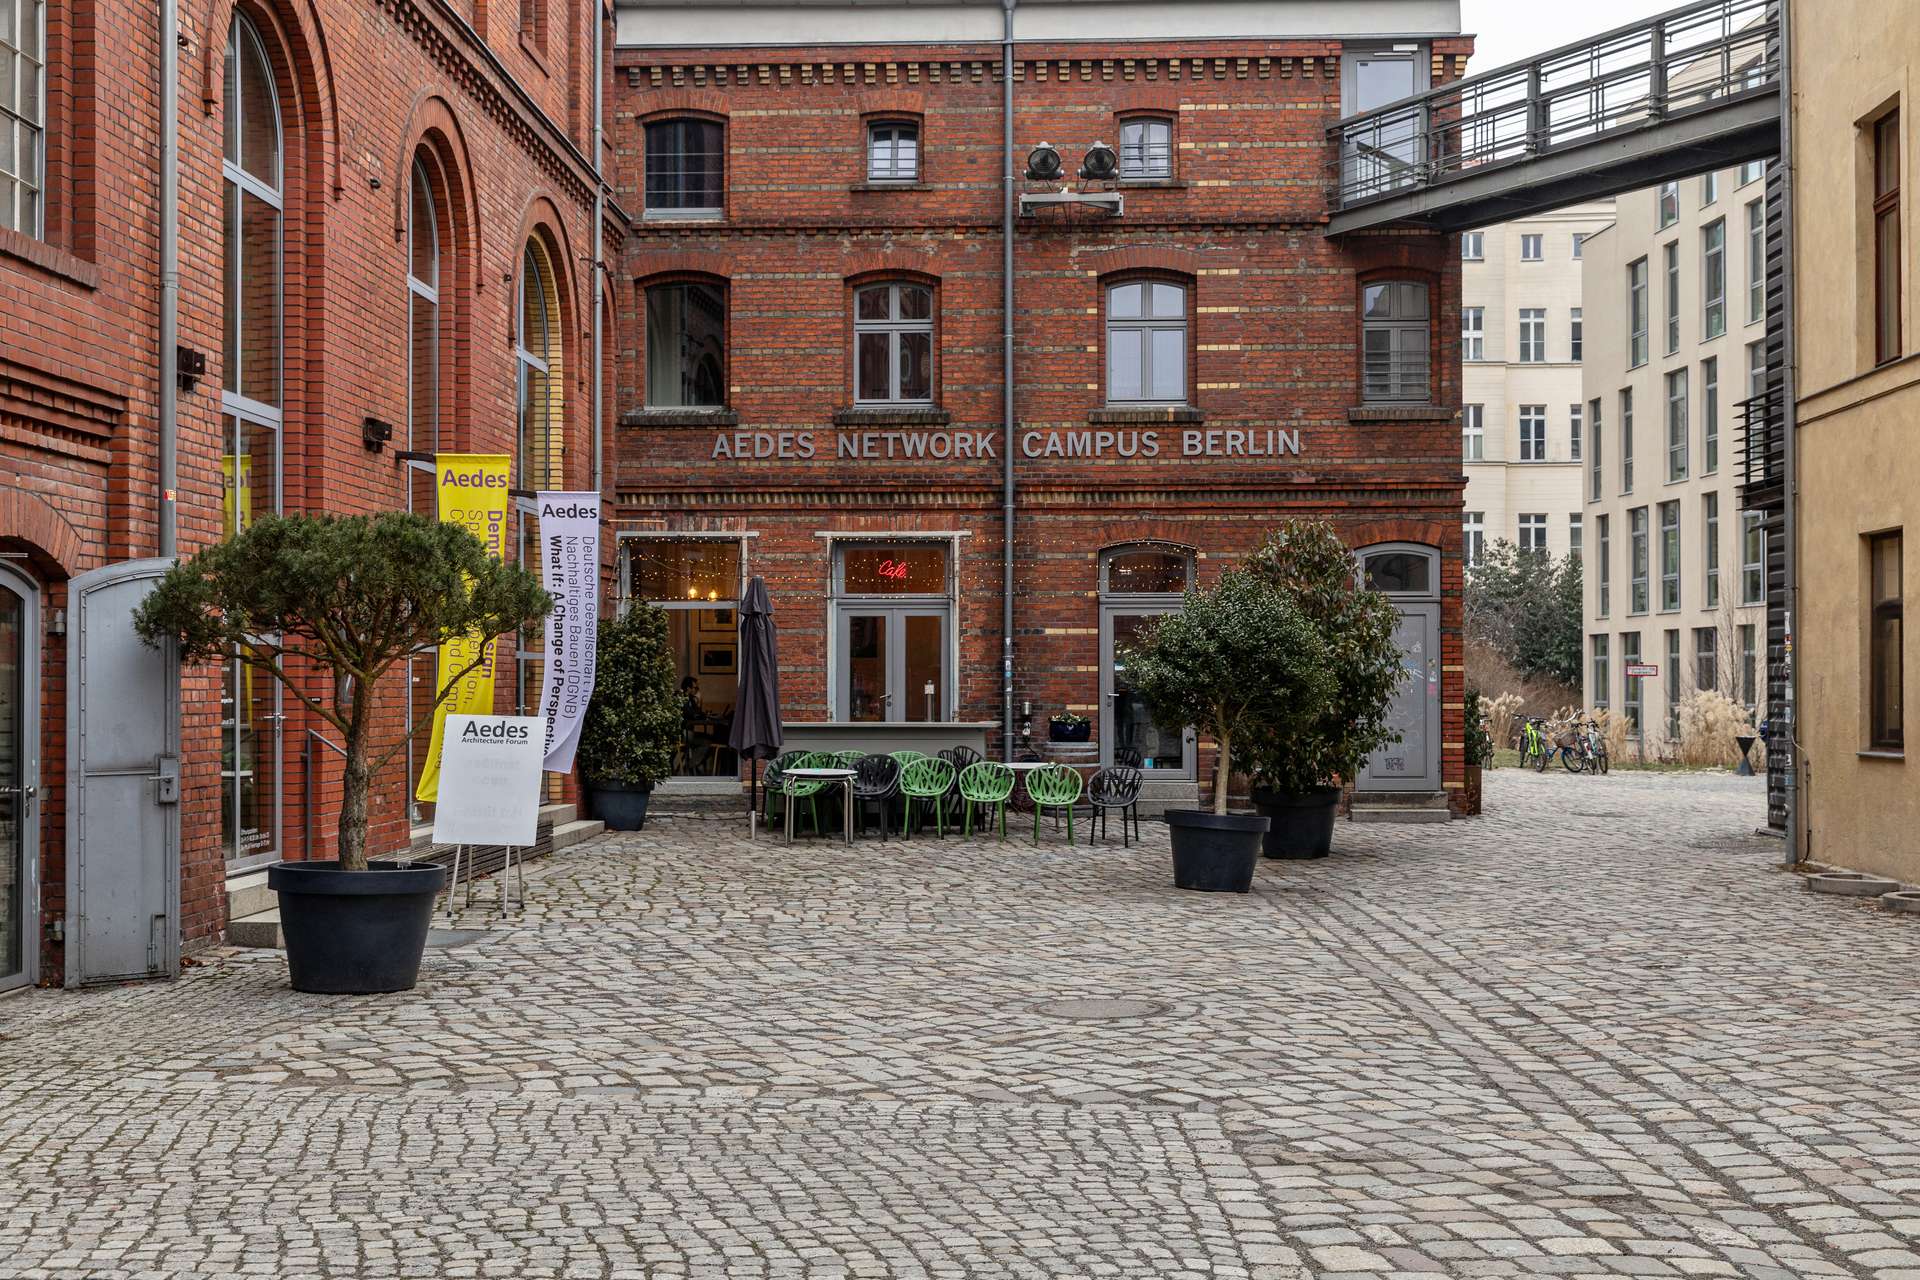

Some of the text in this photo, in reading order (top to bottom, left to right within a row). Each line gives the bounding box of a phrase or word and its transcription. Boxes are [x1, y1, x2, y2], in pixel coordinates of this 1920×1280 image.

[711, 429, 1300, 459] AEDES NETWORK CAMPUS BERLIN
[442, 469, 507, 488] Aedes
[542, 503, 598, 519] Aedes
[550, 535, 562, 569] What
[582, 536, 595, 599] Deutsche
[552, 573, 565, 588] If:
[553, 592, 565, 601] A
[551, 604, 566, 656] Change
[562, 536, 582, 719] Nachhaltiges Bauen (DGNB)
[553, 660, 565, 674] of
[463, 720, 529, 738] Aedes
[461, 737, 504, 745] Architecture
